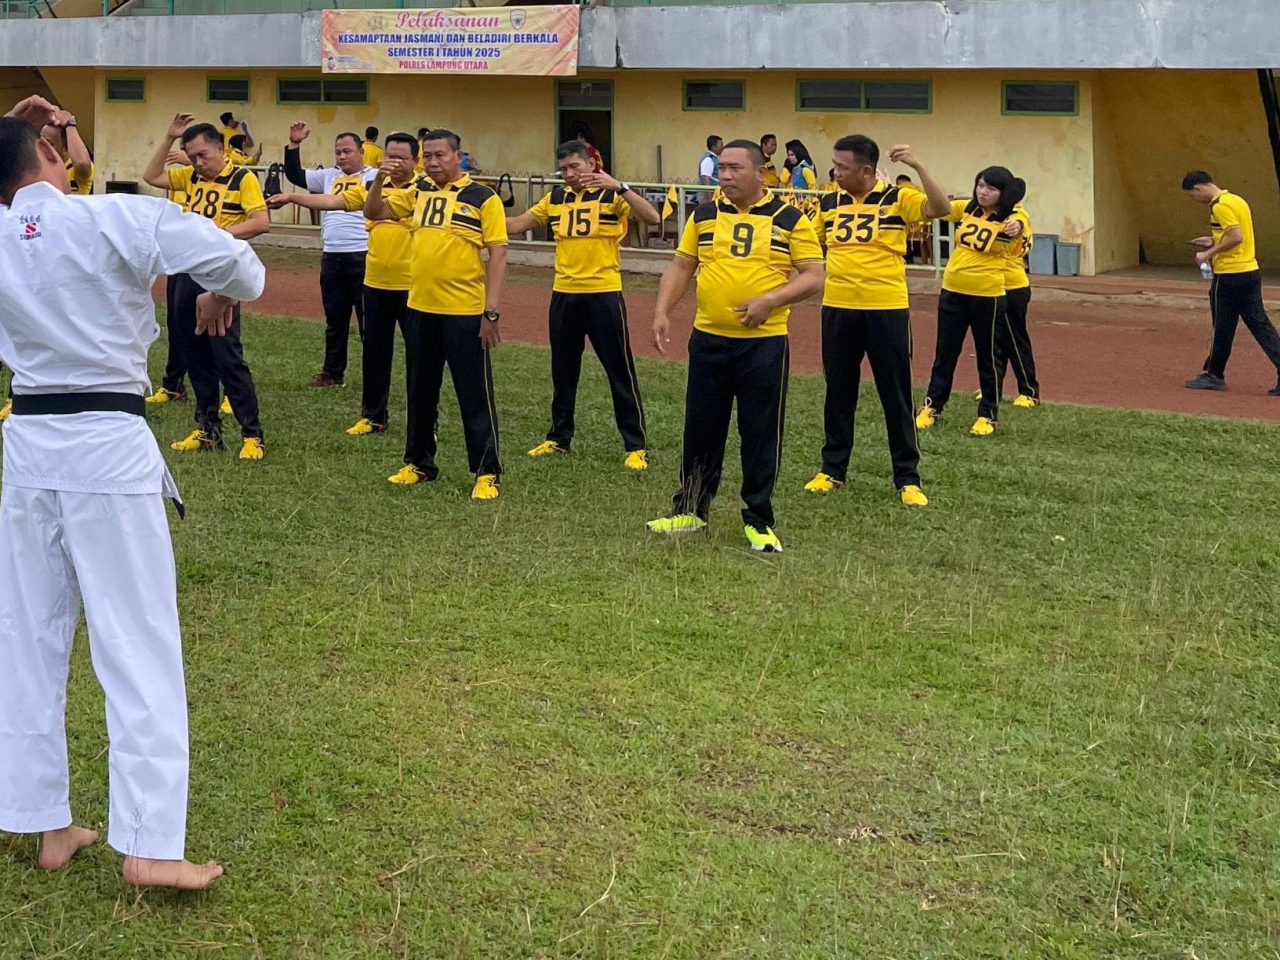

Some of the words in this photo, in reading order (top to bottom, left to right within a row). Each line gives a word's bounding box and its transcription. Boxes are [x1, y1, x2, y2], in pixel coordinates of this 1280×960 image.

[338, 33, 402, 44] KESAMAPTAAN
[403, 33, 444, 44] JASMANI
[446, 33, 465, 44] DAN
[467, 33, 511, 44] BELADIRI
[514, 33, 558, 44] BERKALA
[387, 47, 434, 57] SEMESTER
[442, 47, 473, 57] TAHUN
[475, 47, 501, 57] 2025
[399, 60, 426, 69] POLRES
[427, 60, 462, 70] LAMPUNG
[464, 60, 489, 70] UTARA
[191, 187, 220, 219] 28
[421, 197, 447, 226] 18
[567, 208, 591, 237] 15
[835, 213, 875, 243] 33
[730, 222, 754, 257] 9
[960, 223, 992, 252] 29
